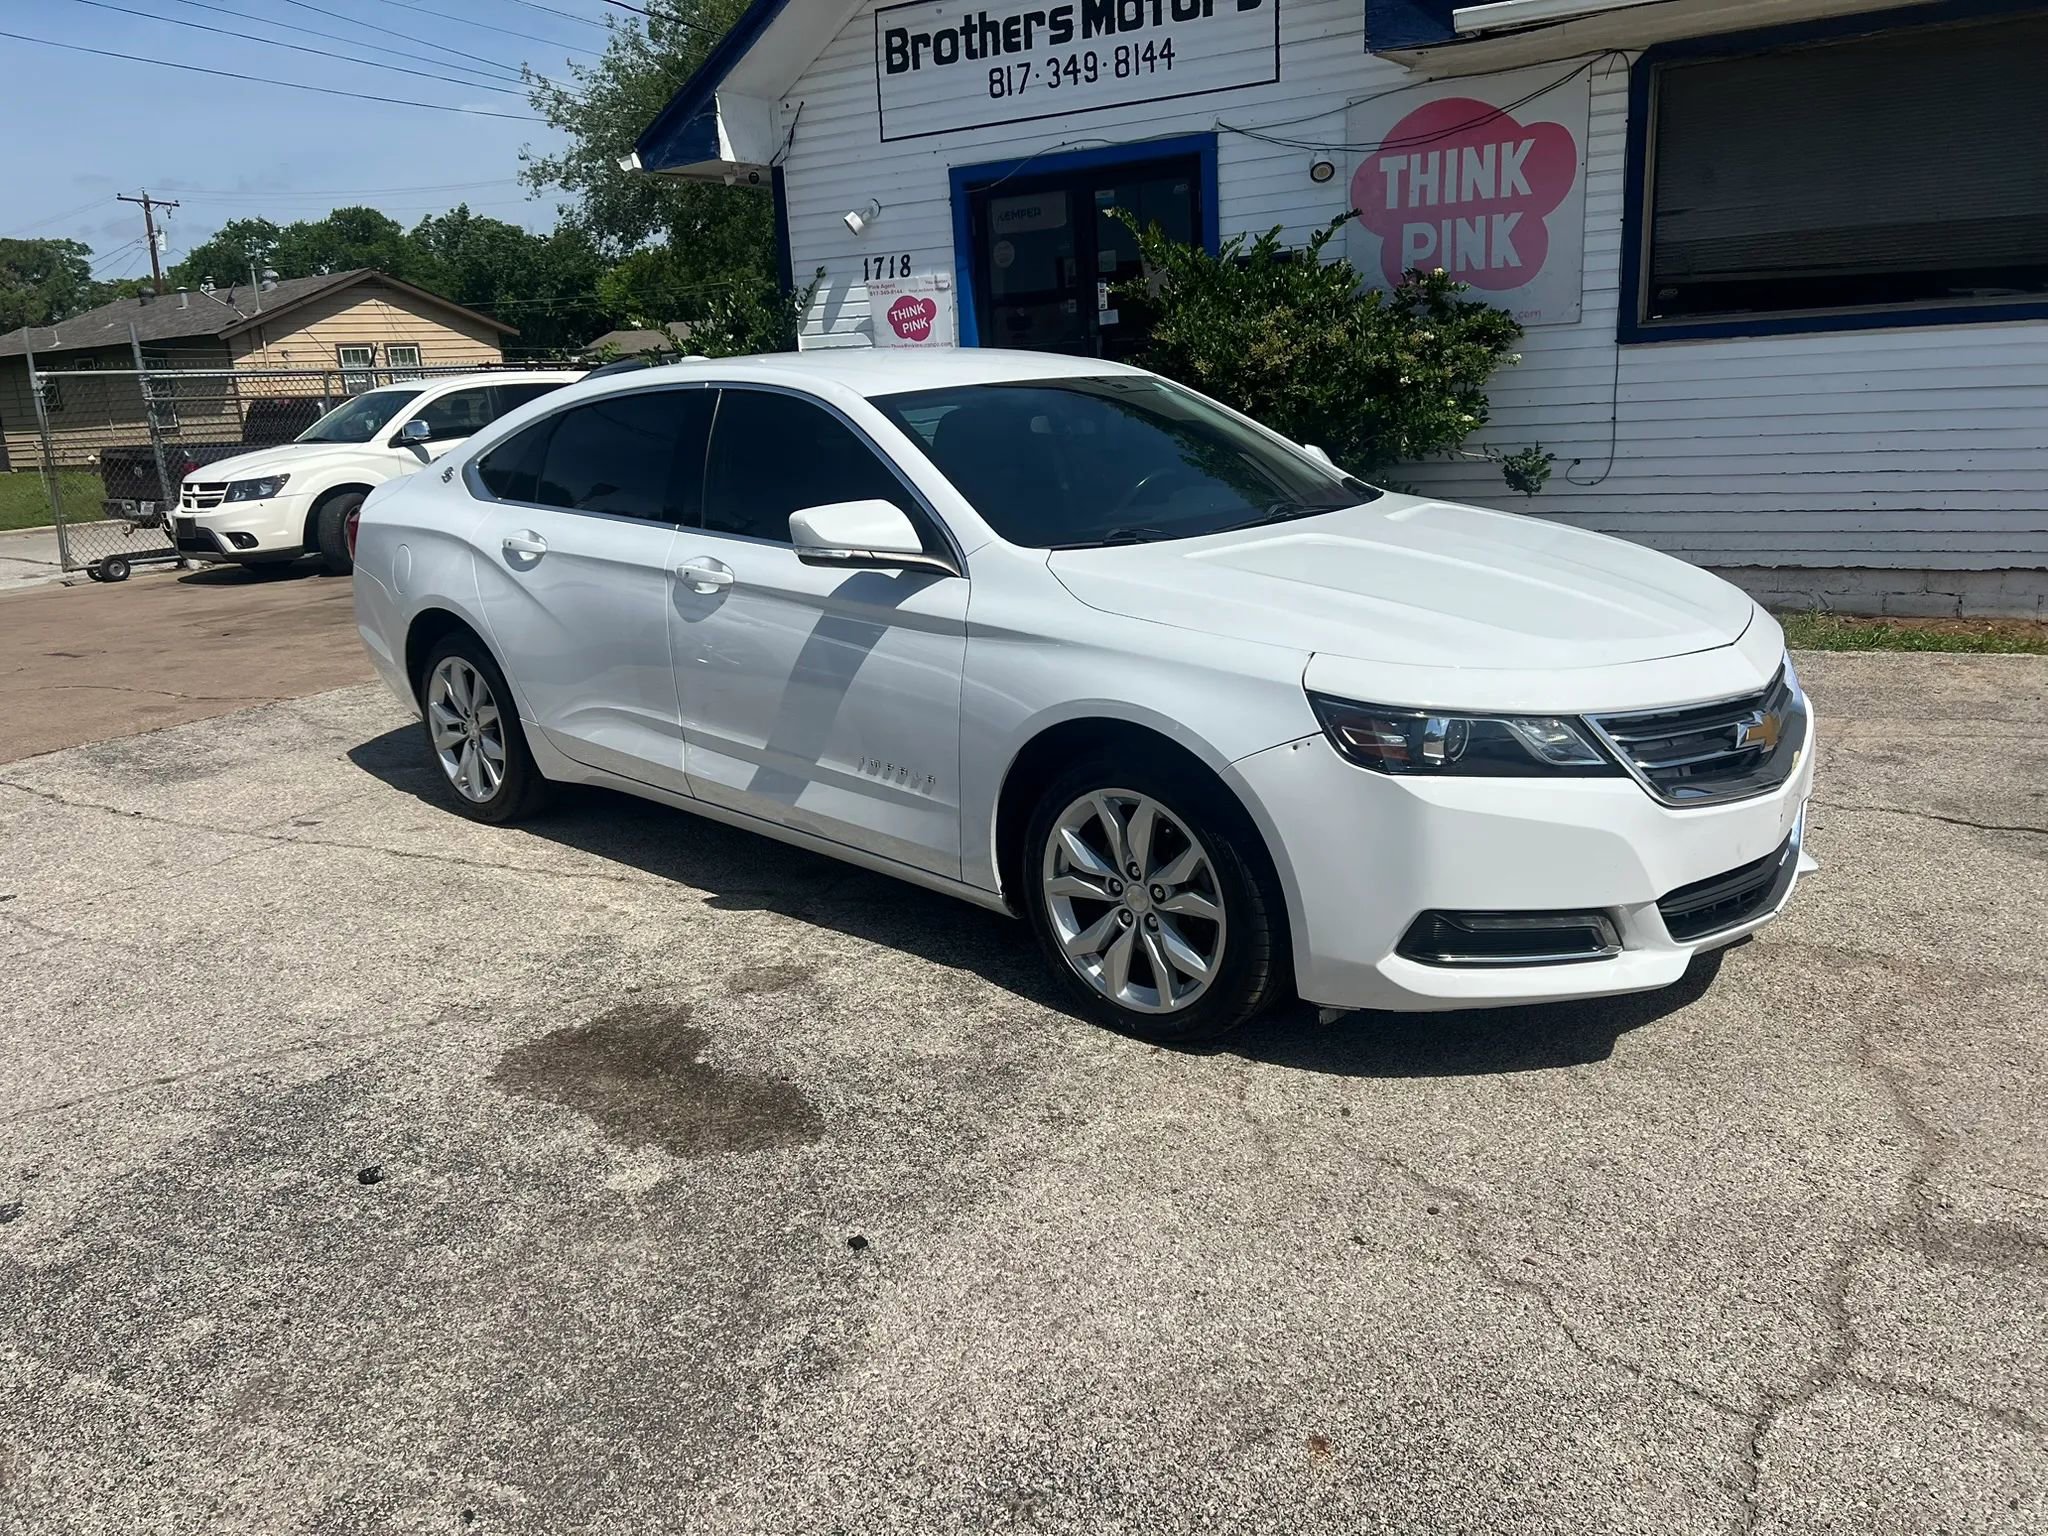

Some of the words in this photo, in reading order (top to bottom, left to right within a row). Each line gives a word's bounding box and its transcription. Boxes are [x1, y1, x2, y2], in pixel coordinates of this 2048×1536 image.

[885, 5, 1074, 75] Brothers
[1380, 138, 1536, 209] THINK
[1402, 211, 1524, 273] PINK
[863, 254, 911, 282] 1718
[891, 302, 926, 322] THINK
[903, 317, 929, 334] PINK
